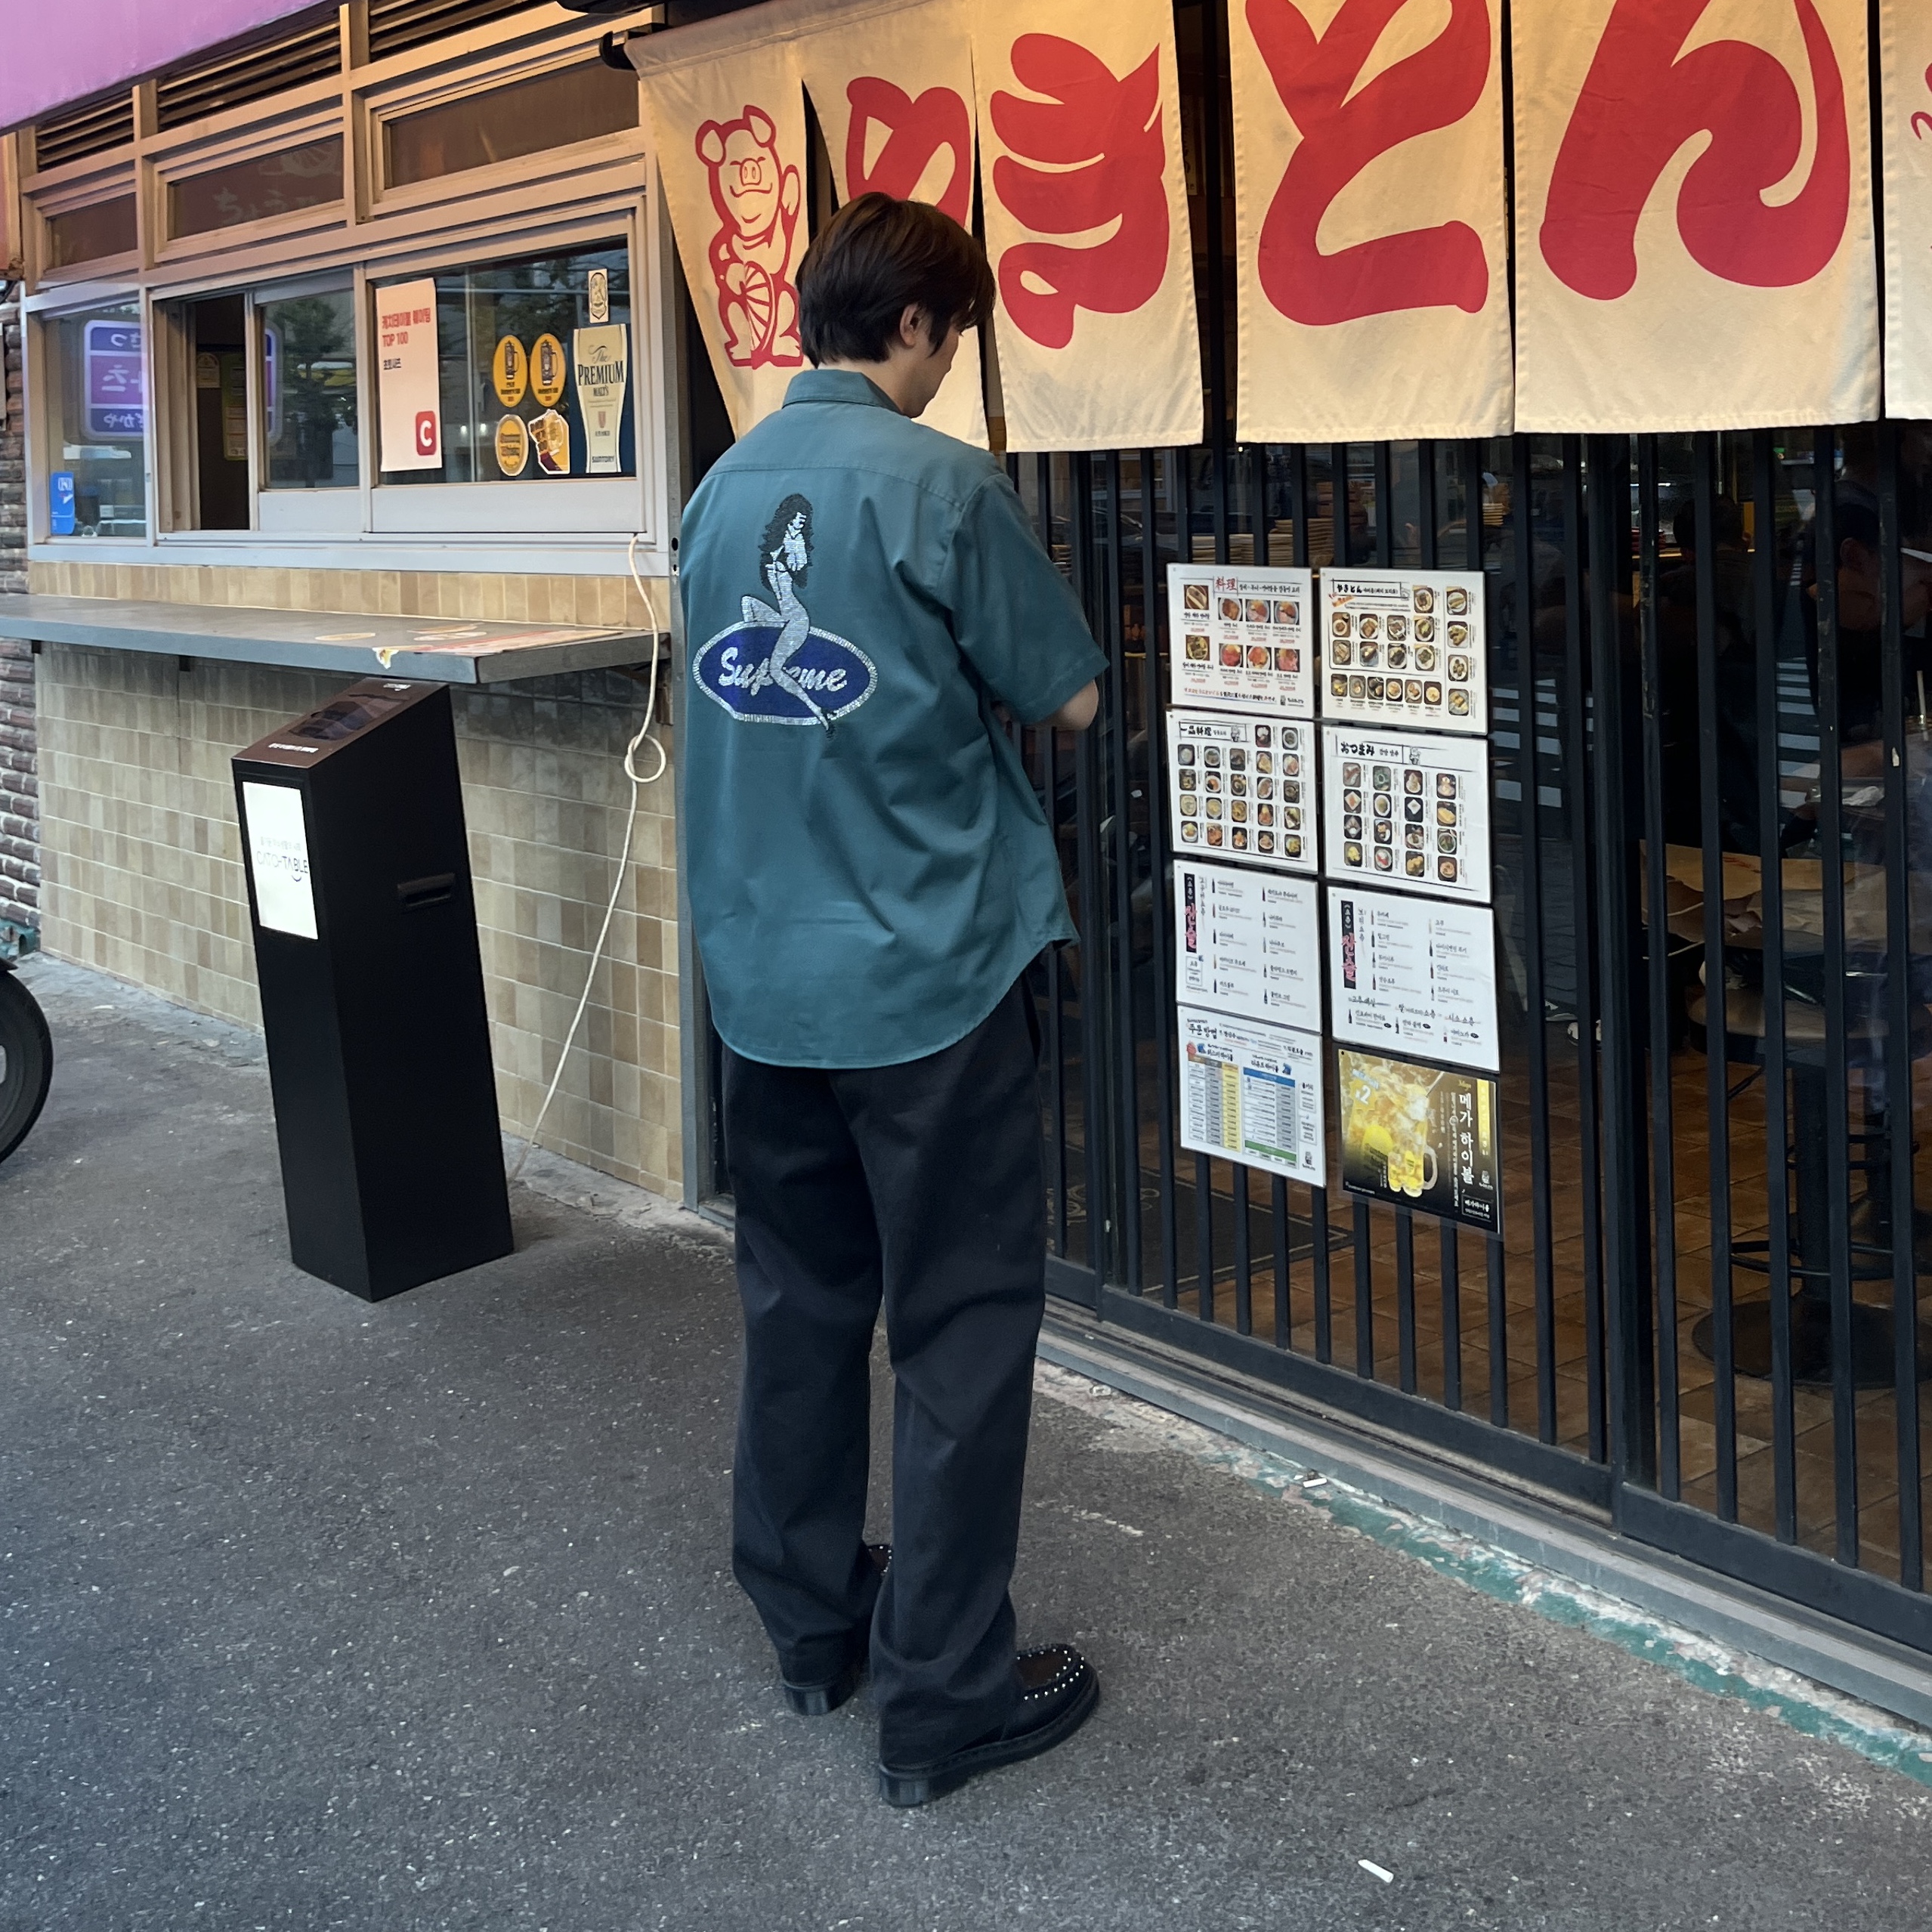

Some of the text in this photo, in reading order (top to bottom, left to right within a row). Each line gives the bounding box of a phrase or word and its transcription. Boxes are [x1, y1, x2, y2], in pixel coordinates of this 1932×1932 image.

[382, 332, 409, 347] TOP 100
[589, 345, 611, 363] The
[578, 360, 625, 386] PREMIUM
[1215, 577, 1237, 592] 料理
[1337, 583, 1362, 594] やきとん
[719, 647, 848, 697] Supme
[1340, 741, 1375, 756] おつまみ
[1189, 1023, 1202, 1036] 주문
[1204, 1027, 1217, 1040] 방법
[1459, 1093, 1474, 1185] 메가 하이볼
